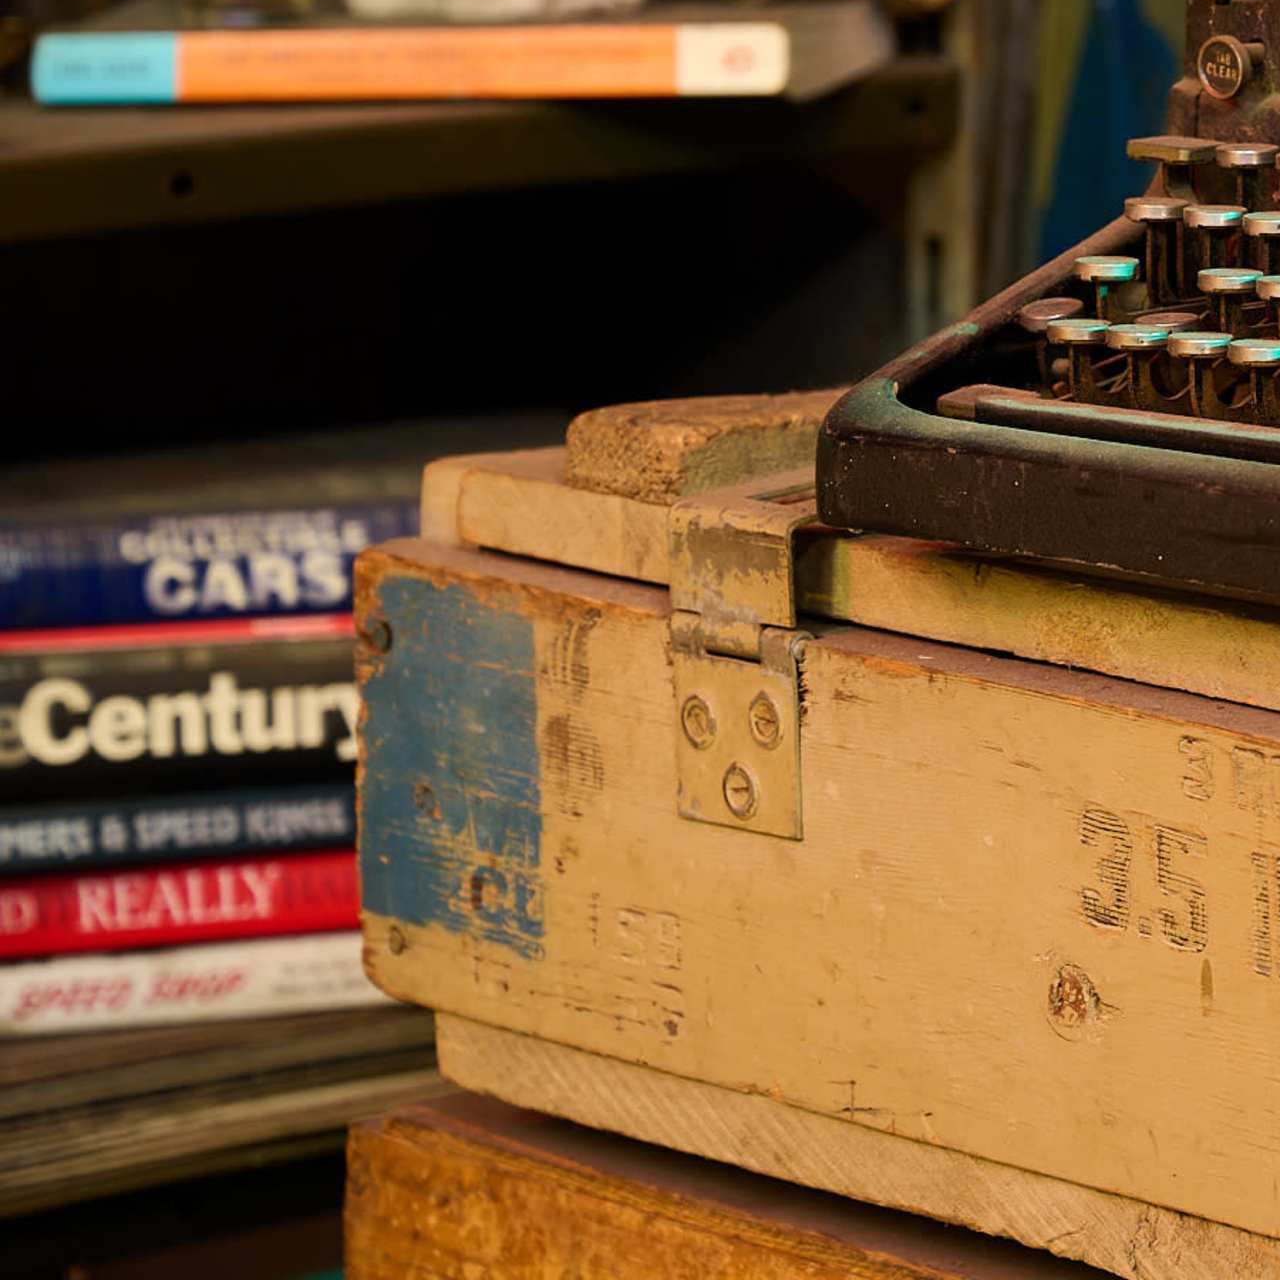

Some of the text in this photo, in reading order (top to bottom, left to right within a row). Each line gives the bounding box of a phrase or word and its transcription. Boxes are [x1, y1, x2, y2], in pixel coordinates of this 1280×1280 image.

[1206, 62, 1239, 81] CLEAR
[143, 550, 350, 615] CARS
[18, 670, 360, 766] Century
[1179, 734, 1215, 801] 3
[135, 805, 240, 851] SPEED
[76, 862, 282, 934] REALLY
[1079, 807, 1209, 954] 3.5
